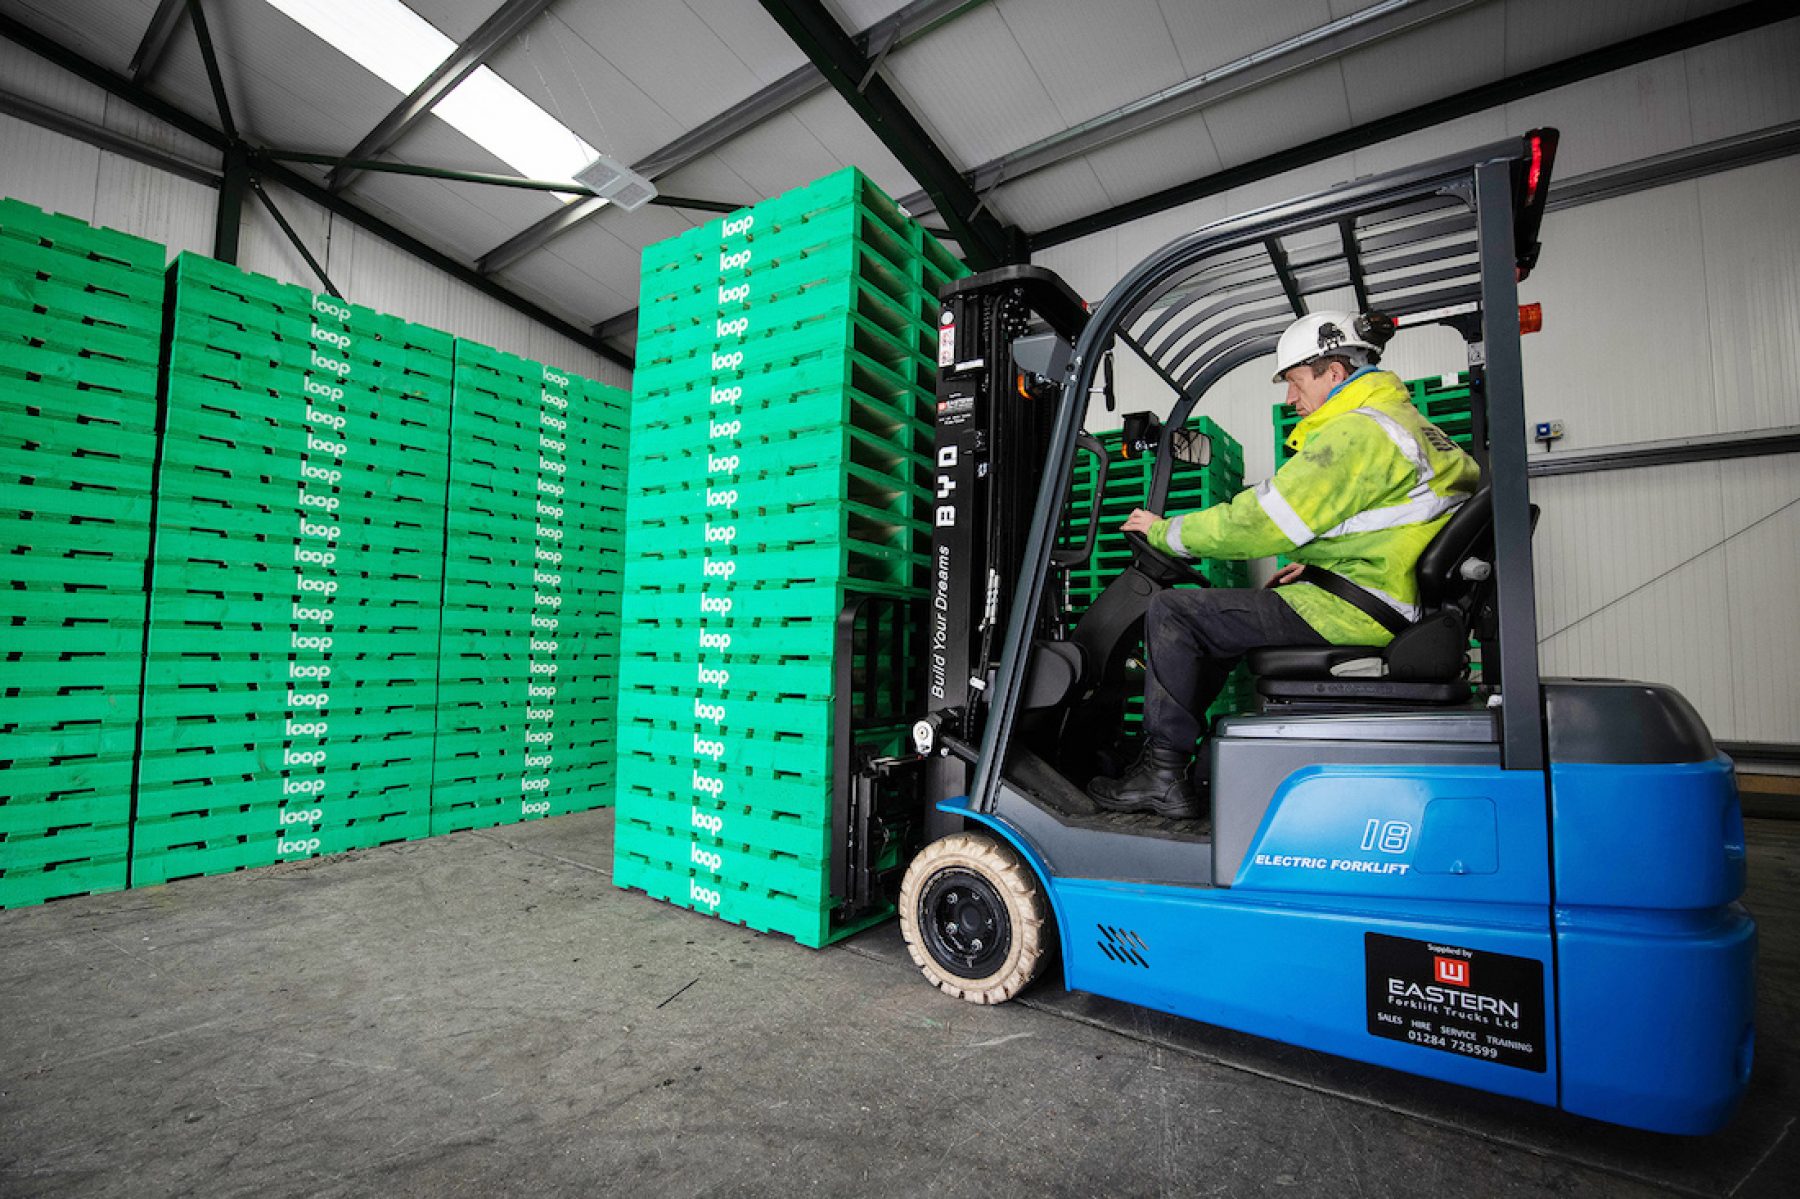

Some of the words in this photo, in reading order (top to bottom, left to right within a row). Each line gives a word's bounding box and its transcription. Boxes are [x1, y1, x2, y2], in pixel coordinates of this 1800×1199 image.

[721, 215, 754, 239] loop
[719, 249, 752, 272] loop
[717, 283, 751, 305] loop
[311, 293, 351, 322] loop
[310, 322, 351, 350] loop
[716, 317, 749, 338] loop
[311, 349, 351, 377] loop
[711, 351, 744, 371] loop
[542, 365, 571, 388] loop
[303, 376, 344, 402] loop
[541, 388, 569, 410] loop
[709, 385, 743, 406] loop
[305, 404, 347, 430] loop
[540, 411, 567, 432] loop
[709, 419, 742, 440] loop
[307, 432, 348, 458] loop
[539, 433, 567, 453] loop
[300, 460, 342, 486] loop
[539, 456, 567, 476] loop
[707, 453, 740, 476] loop
[537, 477, 565, 498] loop
[936, 445, 958, 528] BYD
[298, 488, 340, 512] loop
[536, 500, 564, 520] loop
[706, 487, 739, 510] loop
[299, 517, 341, 541] loop
[536, 522, 564, 542] loop
[704, 522, 737, 545] loop
[294, 545, 336, 568] loop
[534, 545, 563, 564] loop
[533, 569, 562, 587] loop
[703, 556, 737, 581] loop
[935, 545, 950, 611] Dreams
[297, 574, 338, 597] loop
[534, 591, 562, 609] loop
[700, 592, 733, 618] loop
[292, 602, 334, 625] loop
[531, 613, 559, 631] loop
[291, 631, 333, 653] loop
[699, 627, 732, 653] loop
[933, 612, 947, 651] Your
[529, 636, 559, 654] loop
[289, 661, 331, 682] loop
[529, 659, 559, 677] loop
[697, 662, 730, 689] loop
[931, 653, 946, 700] Build
[287, 689, 330, 710] loop
[528, 682, 557, 699] loop
[526, 705, 554, 722] loop
[693, 697, 726, 726] loop
[285, 718, 328, 738] loop
[525, 729, 554, 745] loop
[283, 748, 327, 767] loop
[693, 732, 725, 762] loop
[524, 753, 554, 769] loop
[283, 777, 326, 796] loop
[521, 777, 551, 792] loop
[692, 769, 724, 799] loop
[279, 808, 323, 825] loop
[521, 800, 551, 815] loop
[691, 805, 723, 837] loop
[277, 836, 321, 855] loop
[1360, 818, 1413, 854] 18
[690, 841, 723, 874] loop
[1254, 854, 1327, 870] ELECTRIC
[1329, 859, 1410, 876] FORKLIFT
[689, 877, 721, 911] loop
[1426, 943, 1461, 956] Supplied
[1462, 949, 1473, 959] by
[1388, 978, 1519, 1019] EASTERN
[1387, 995, 1440, 1014] Forklift
[1443, 1006, 1489, 1024] Trucks
[1495, 1017, 1519, 1030] Ltd
[1376, 1011, 1403, 1025] SALES
[1411, 1019, 1433, 1031] HIRE
[1439, 1024, 1477, 1041] SERVICE
[1485, 1034, 1534, 1053] TRAINING
[1407, 1029, 1447, 1047] 01284
[1450, 1039, 1498, 1059] 725599
